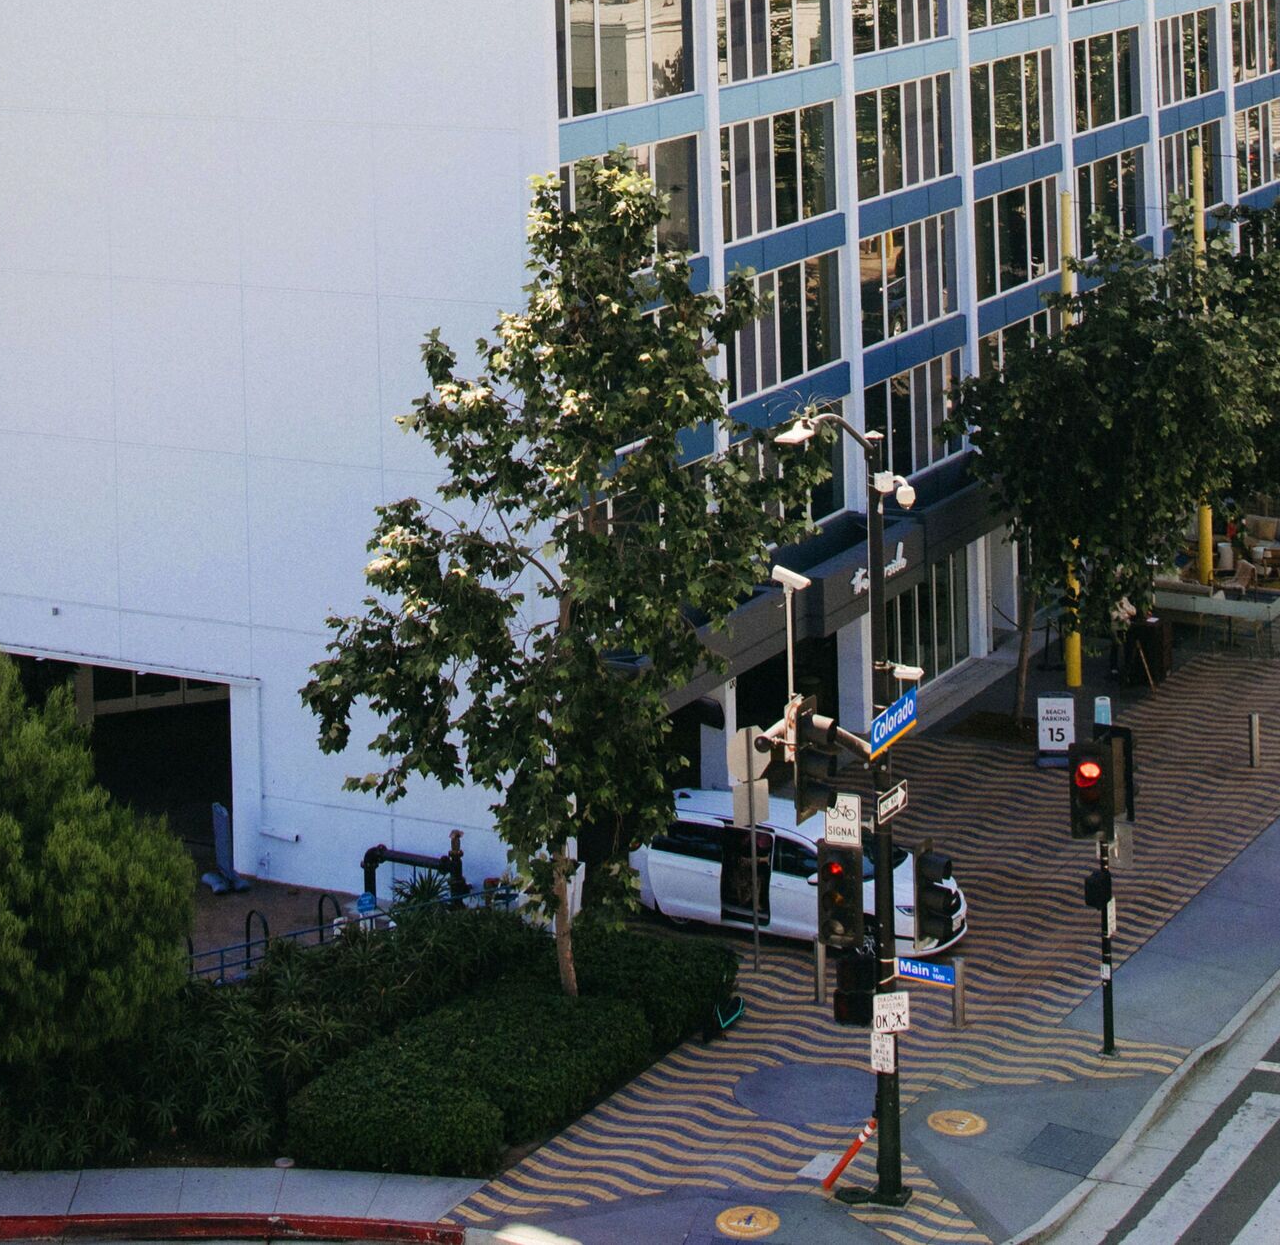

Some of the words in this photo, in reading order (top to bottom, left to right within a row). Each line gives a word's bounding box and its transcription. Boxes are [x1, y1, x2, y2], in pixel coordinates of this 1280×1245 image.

[873, 696, 914, 743] Colorado
[827, 825, 857, 838] SIGNAL
[900, 960, 930, 977] Main
[877, 995, 905, 1003] DIAGONAL
[877, 1002, 905, 1010] CROSSING
[876, 1014, 888, 1029] OK
[873, 1035, 892, 1044] CROSS
